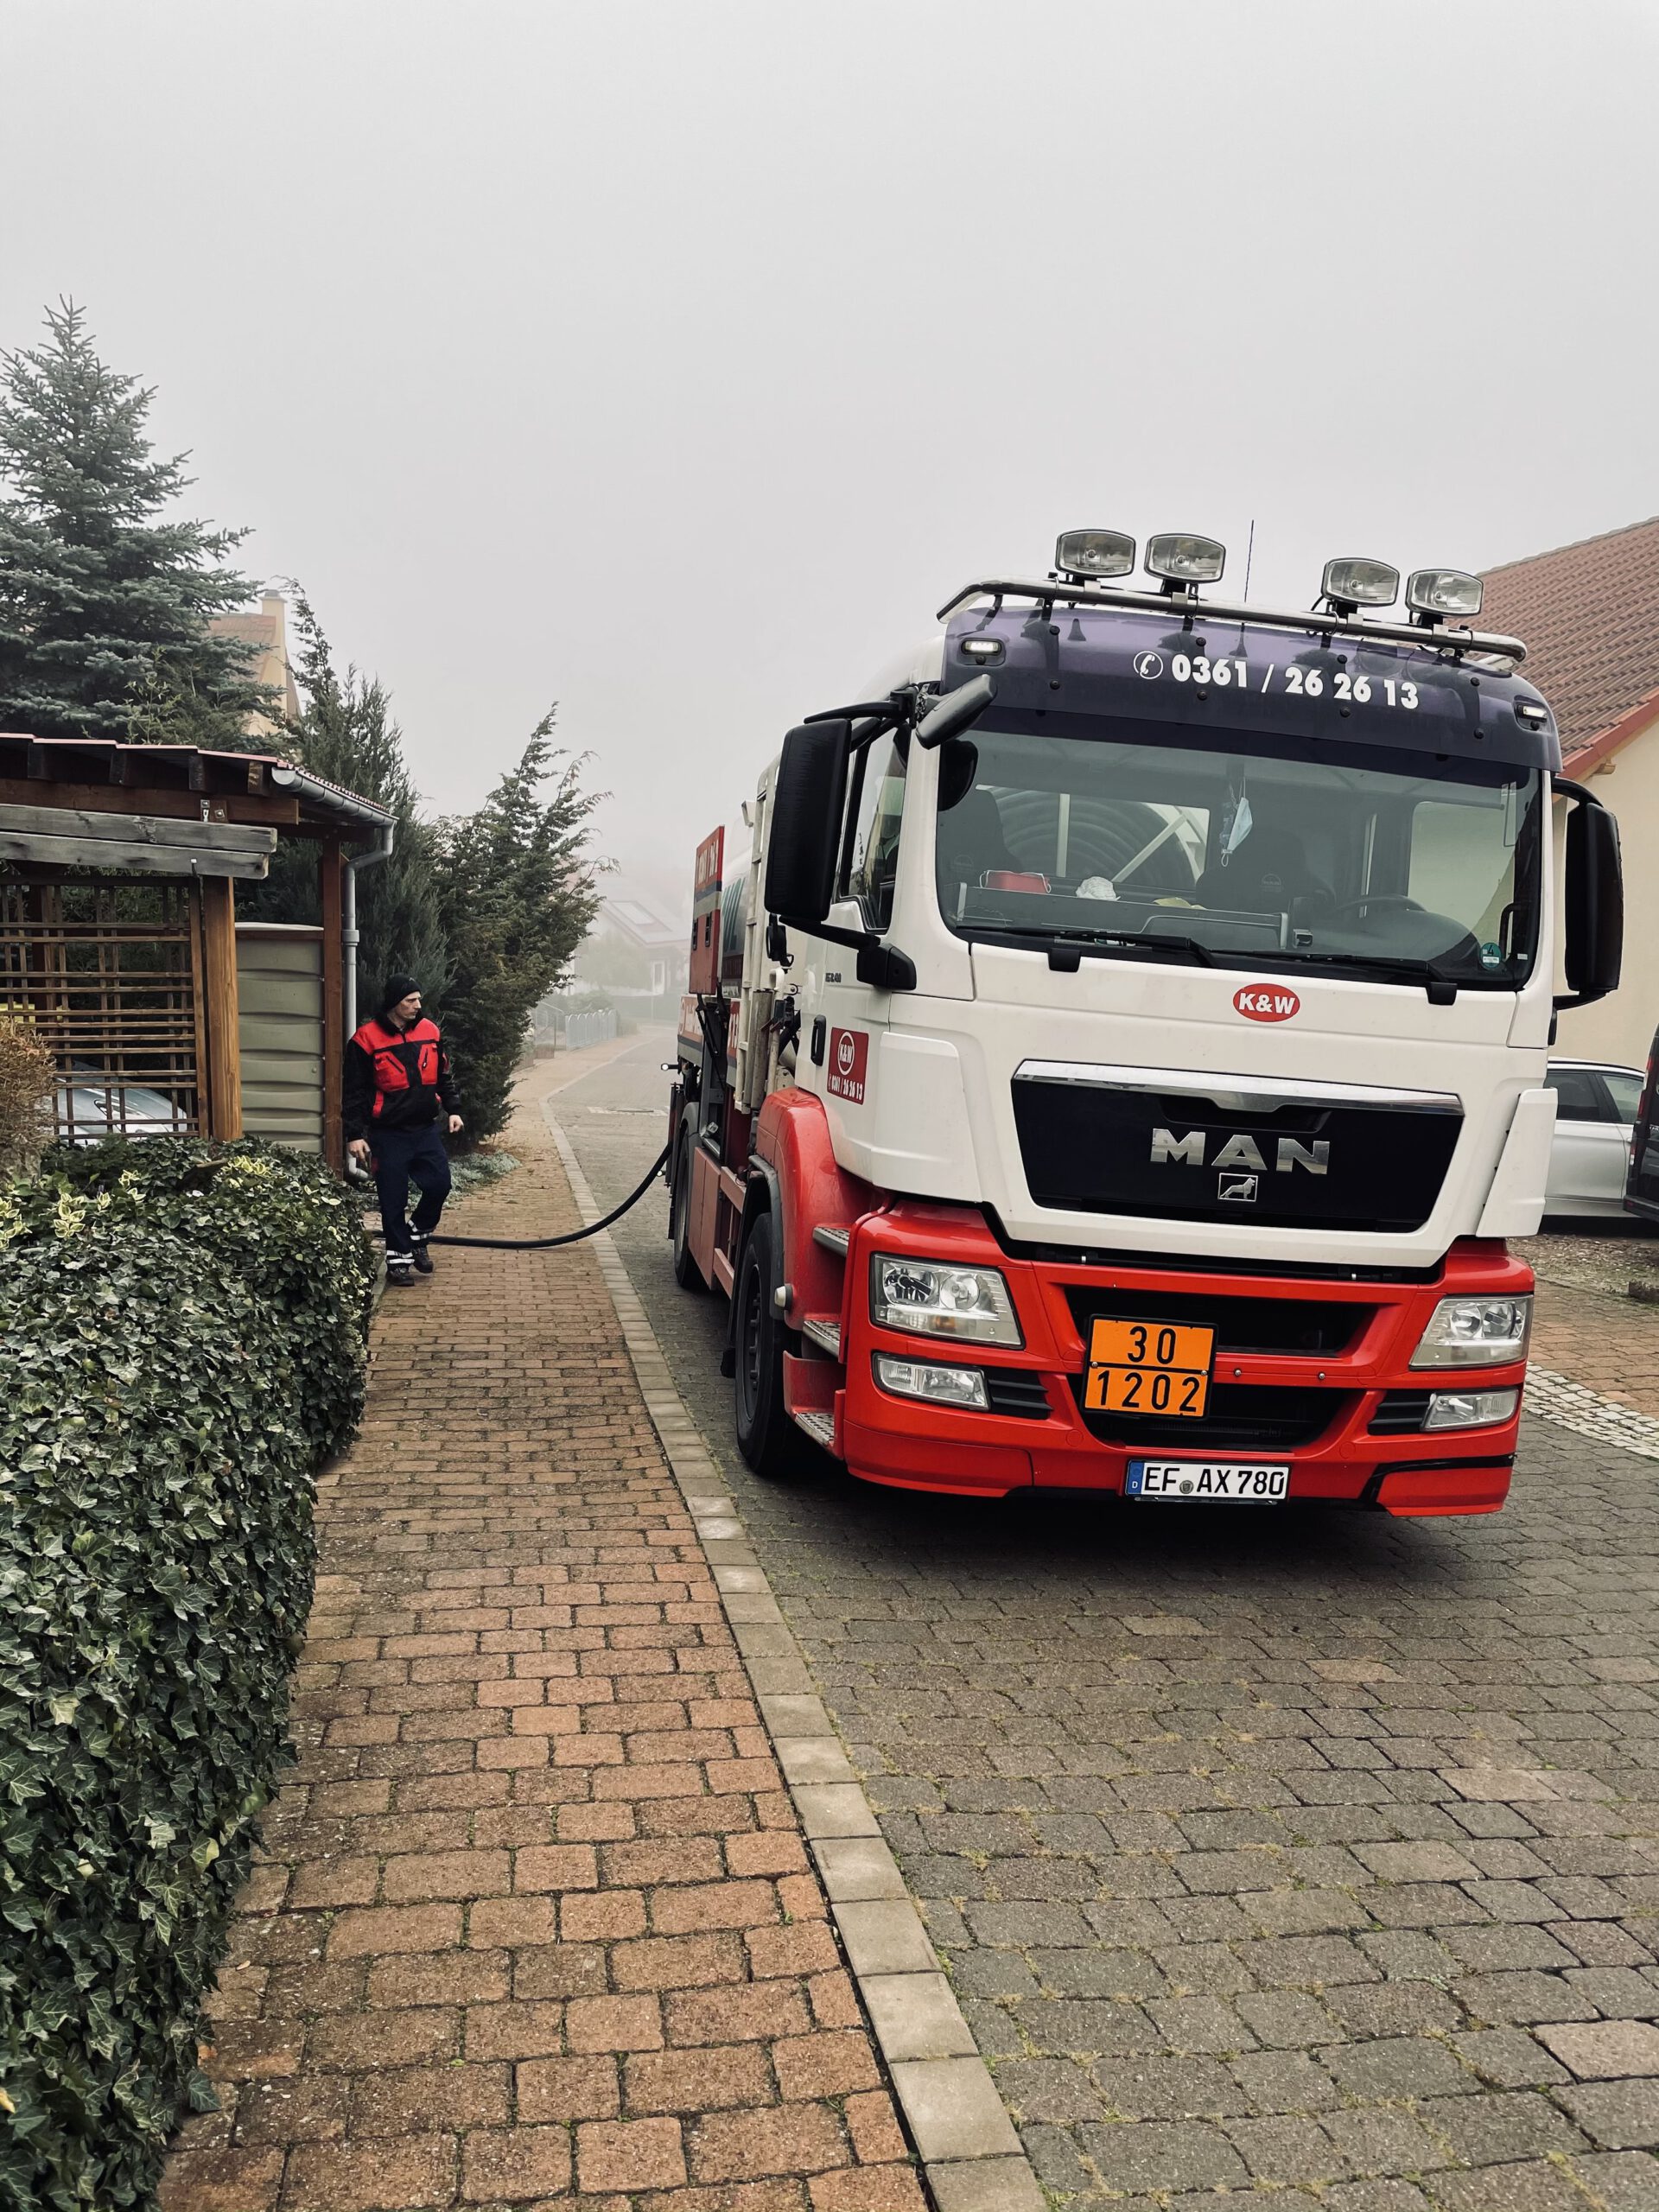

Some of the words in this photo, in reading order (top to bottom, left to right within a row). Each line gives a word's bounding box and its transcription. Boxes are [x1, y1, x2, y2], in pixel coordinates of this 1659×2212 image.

[1172, 654, 1247, 688] 0361
[1261, 664, 1274, 693] /
[1285, 667, 1323, 696] 26
[1333, 673, 1371, 702] 26
[1383, 679, 1419, 709] 13
[1487, 944, 1495, 957] 4
[1239, 993, 1295, 1014] K&W
[840, 1044, 853, 1063] K&W
[1150, 1128, 1330, 1174] MAN
[1128, 1326, 1176, 1364] 30
[1097, 1370, 1200, 1412] 1202
[1144, 1466, 1180, 1491] EF
[1196, 1468, 1231, 1493] AX
[1237, 1471, 1284, 1495] 780
